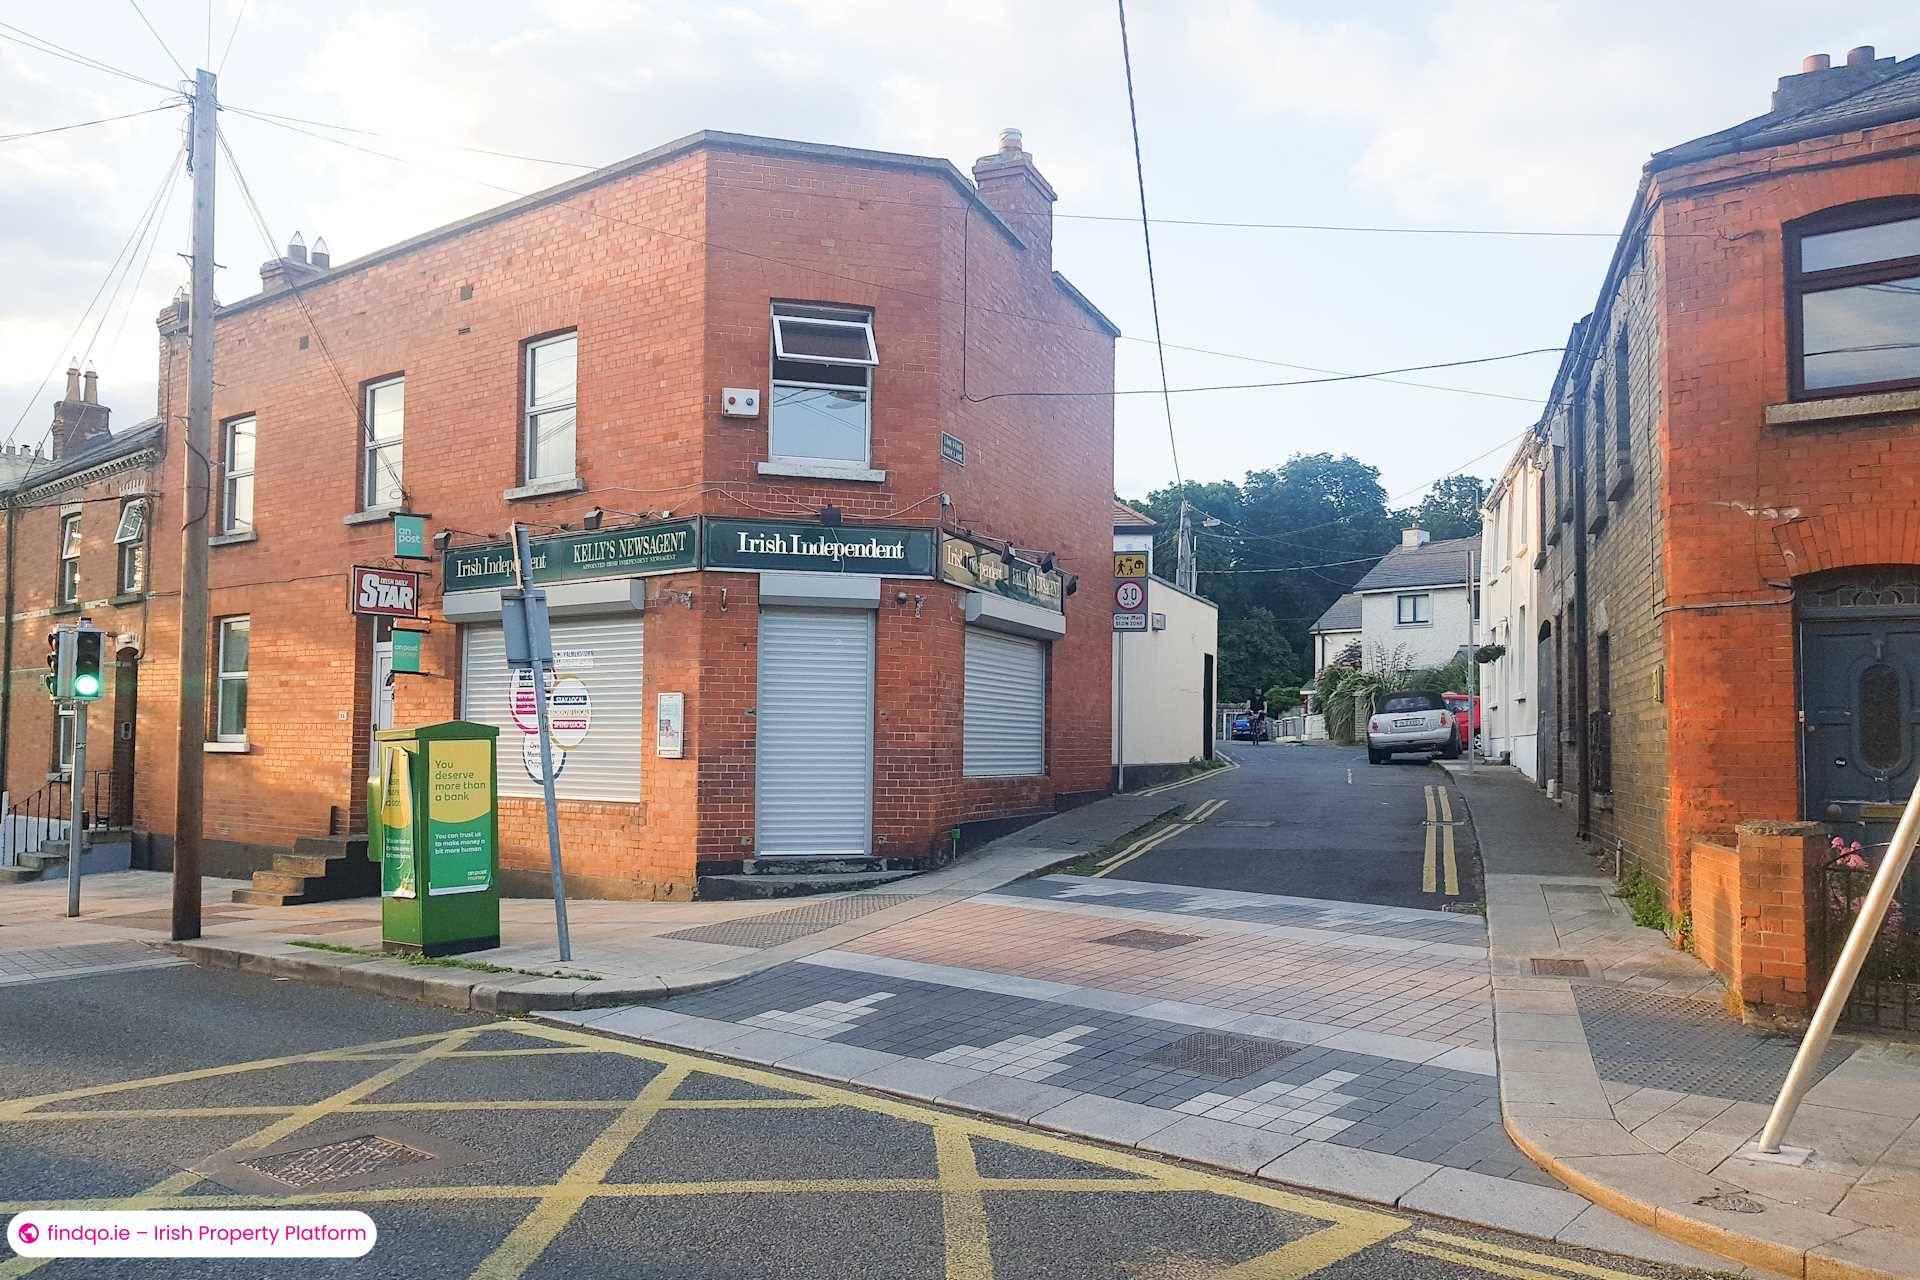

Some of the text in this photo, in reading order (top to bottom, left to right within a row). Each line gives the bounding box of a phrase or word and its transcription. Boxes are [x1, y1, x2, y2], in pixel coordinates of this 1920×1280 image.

[398, 527, 411, 536] an
[398, 533, 421, 544] post
[573, 531, 687, 563] KELLY'S NEWSAGENT
[737, 531, 904, 562] Irish Independent
[455, 557, 483, 579] Irish
[359, 573, 413, 610] STAR
[1123, 588, 1137, 600] 30
[435, 760, 454, 769] You
[435, 770, 474, 780] deserve
[435, 781, 486, 791] more than
[444, 793, 469, 801] bank
